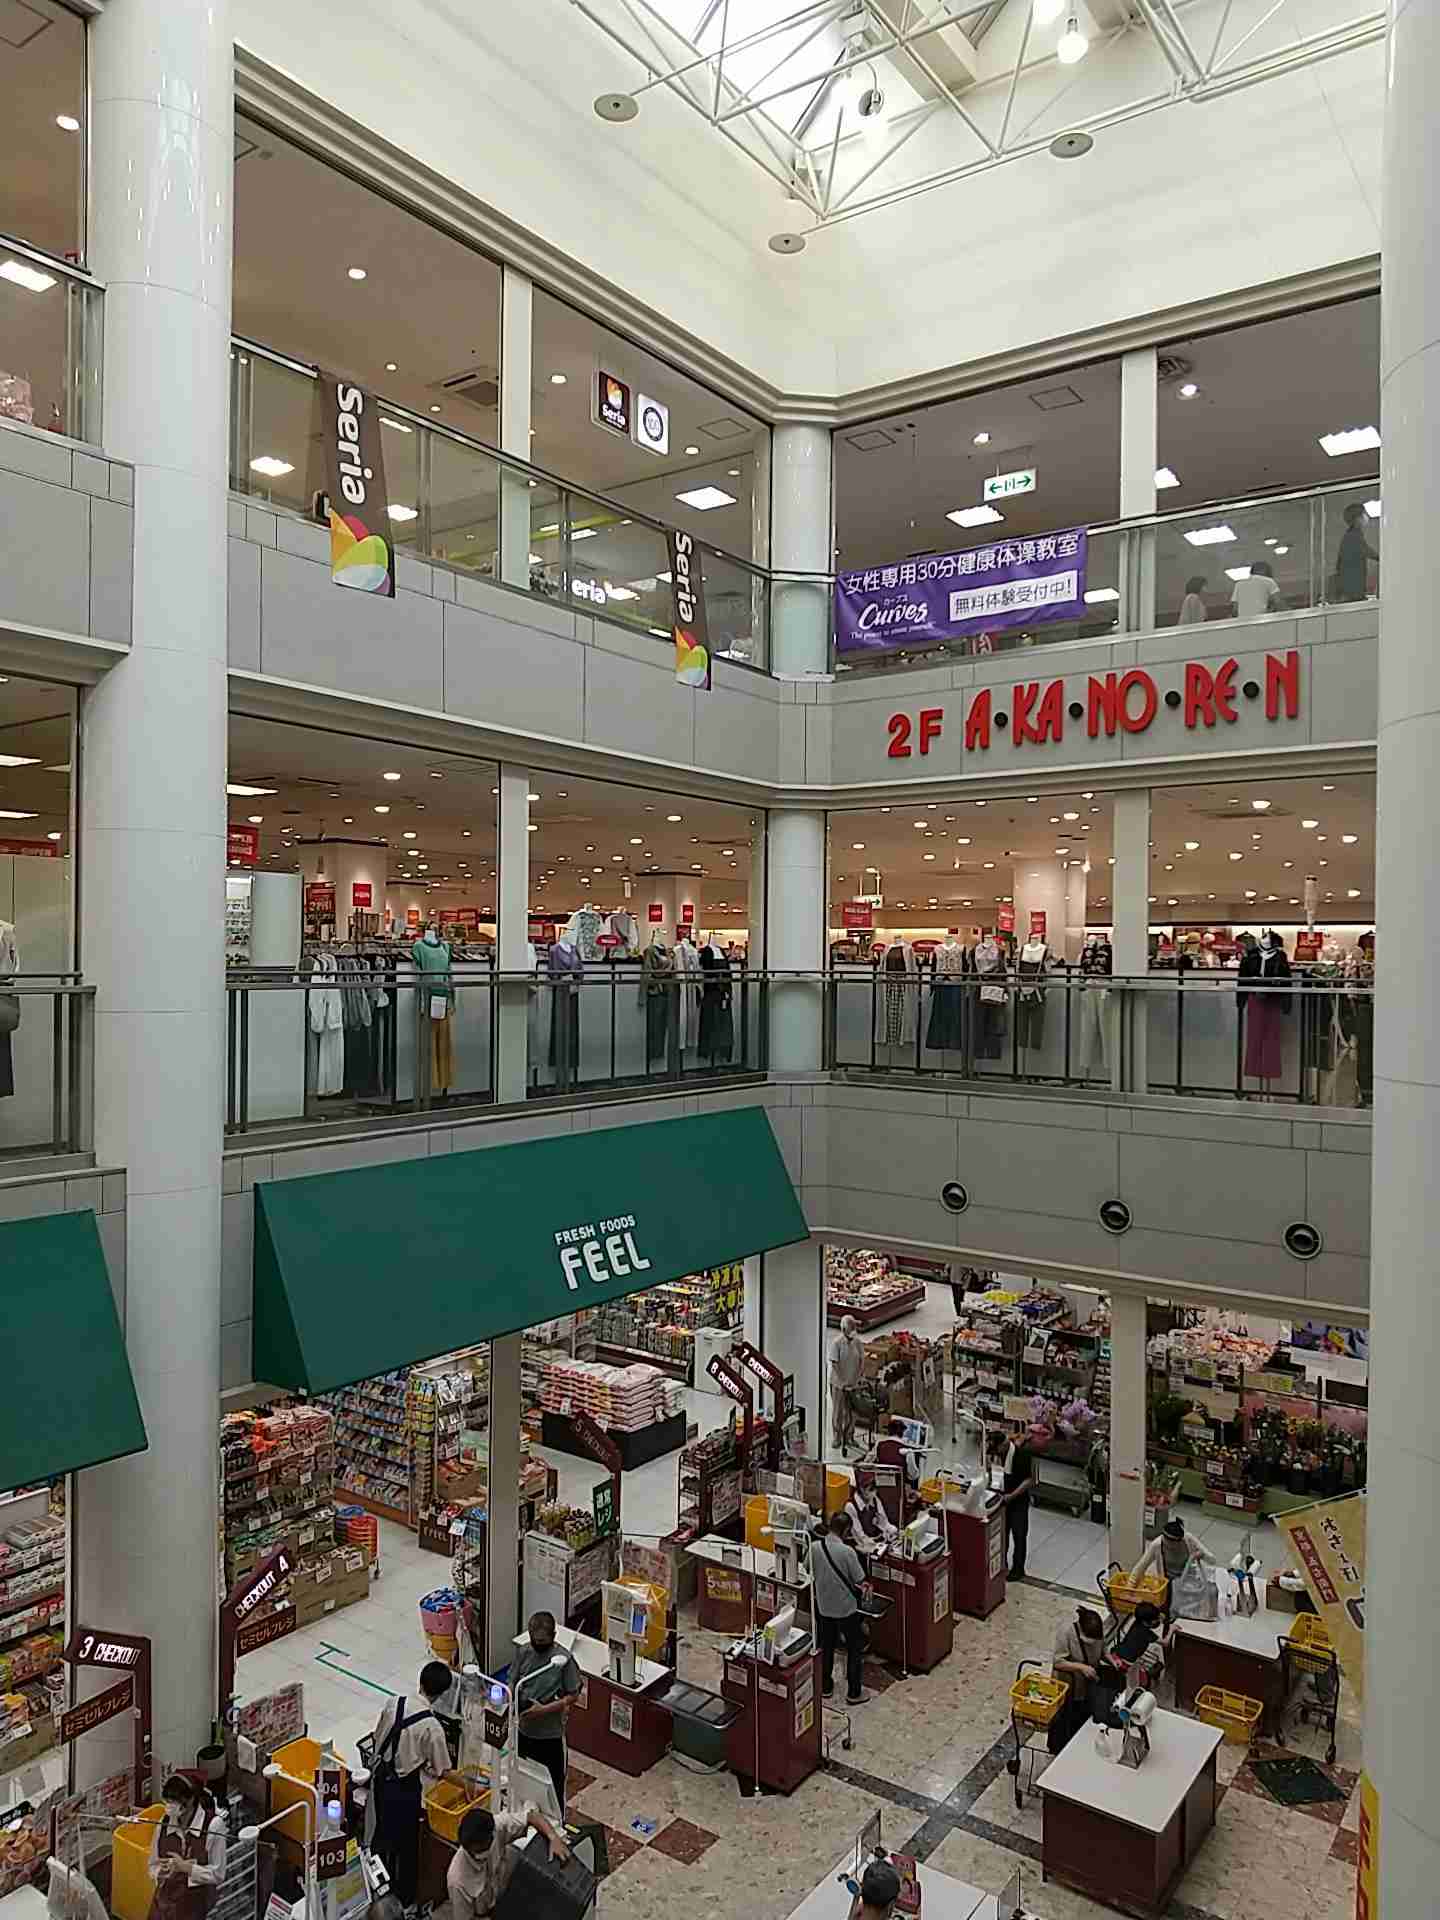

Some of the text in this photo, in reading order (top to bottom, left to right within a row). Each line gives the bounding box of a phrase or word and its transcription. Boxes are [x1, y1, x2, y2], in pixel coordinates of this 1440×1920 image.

[858, 602, 929, 630] Curves
[887, 707, 943, 758] 2F
[555, 1215, 636, 1246] FRESH FOODS
[560, 1232, 650, 1290] FEEL
[710, 1361, 719, 1374] 8
[234, 1555, 289, 1619] CHECKOUT 4
[79, 1635, 143, 1665] 3 CHECKOUT
[319, 1849, 345, 1867] 103
